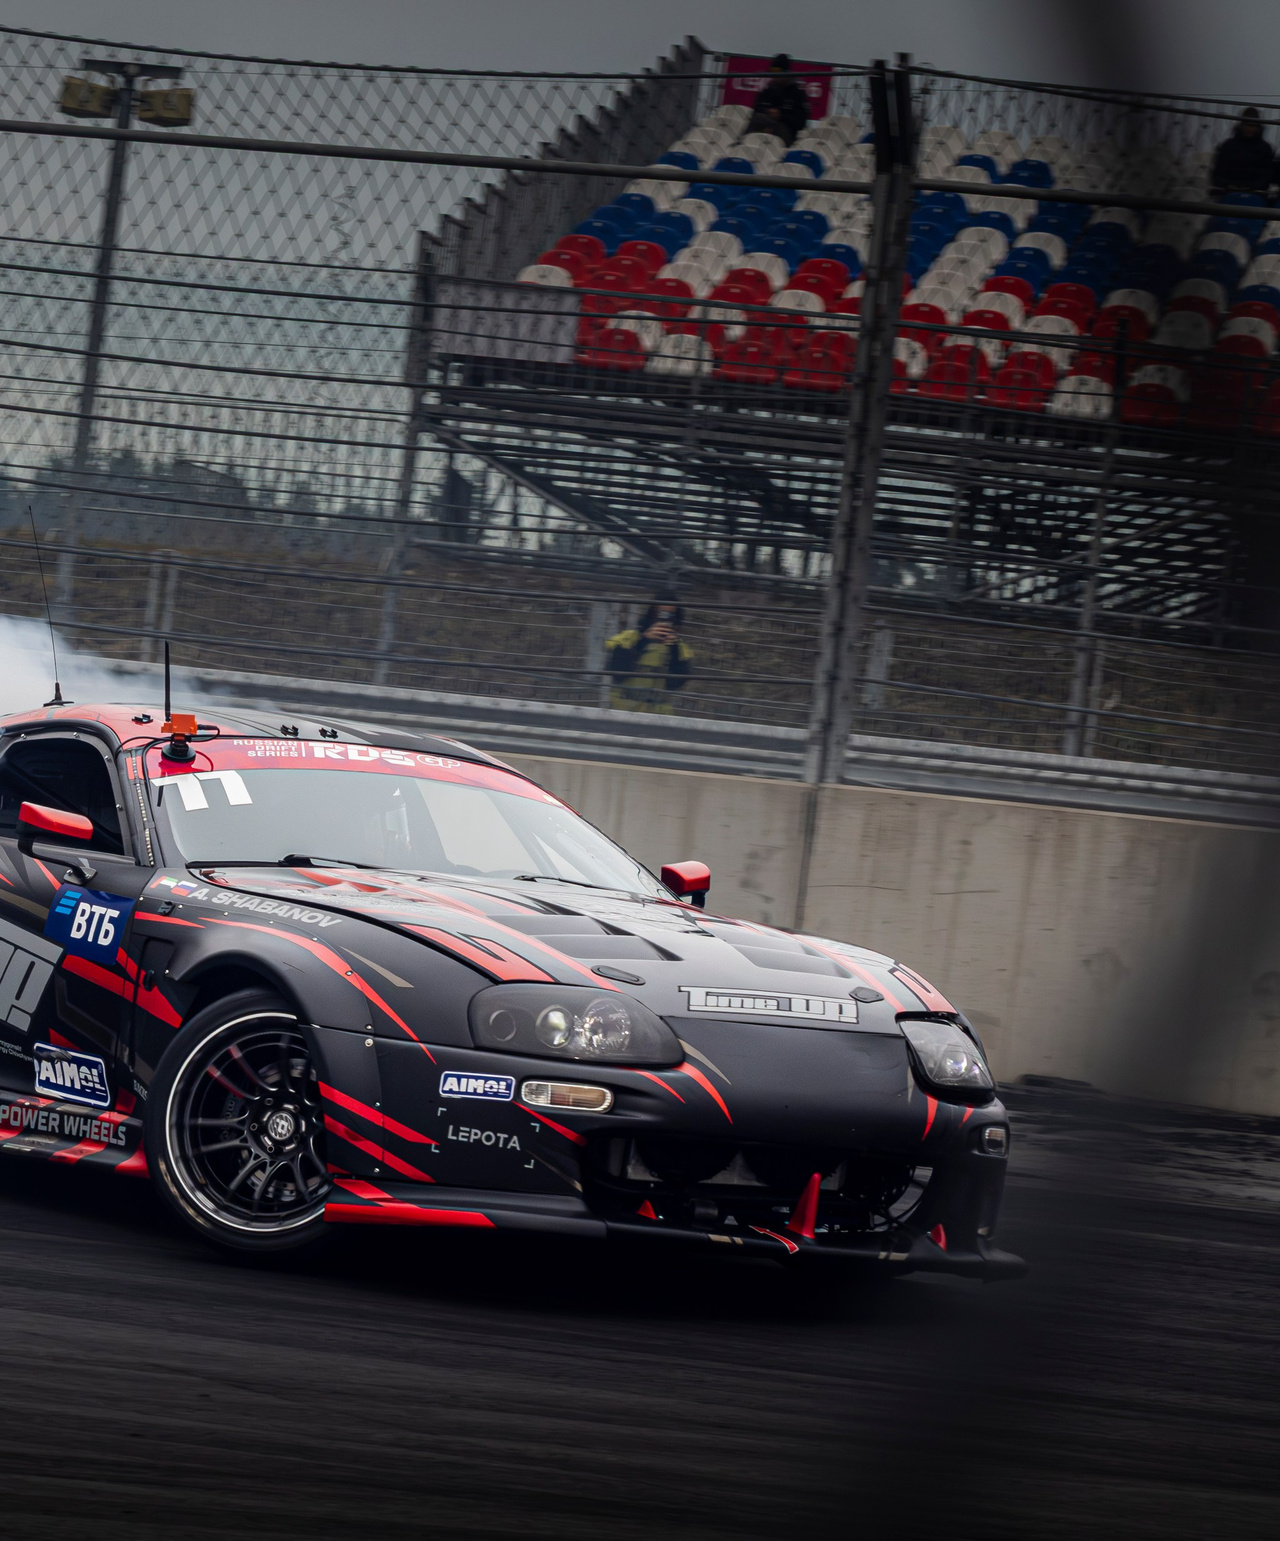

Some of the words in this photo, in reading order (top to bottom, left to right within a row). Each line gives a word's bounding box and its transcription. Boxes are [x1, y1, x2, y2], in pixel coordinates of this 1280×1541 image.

[233, 739, 297, 747] RUSSIAN
[247, 750, 298, 758] SERIES
[308, 742, 416, 767] RDS
[187, 888, 208, 901] A.
[211, 892, 342, 928] SHABANOV
[70, 901, 120, 946] ВТБ
[39, 1060, 107, 1096] AIMOL
[443, 1077, 510, 1096] AIMOL
[63, 1114, 127, 1146] WHEELS
[447, 1124, 521, 1151] LEPOTA
